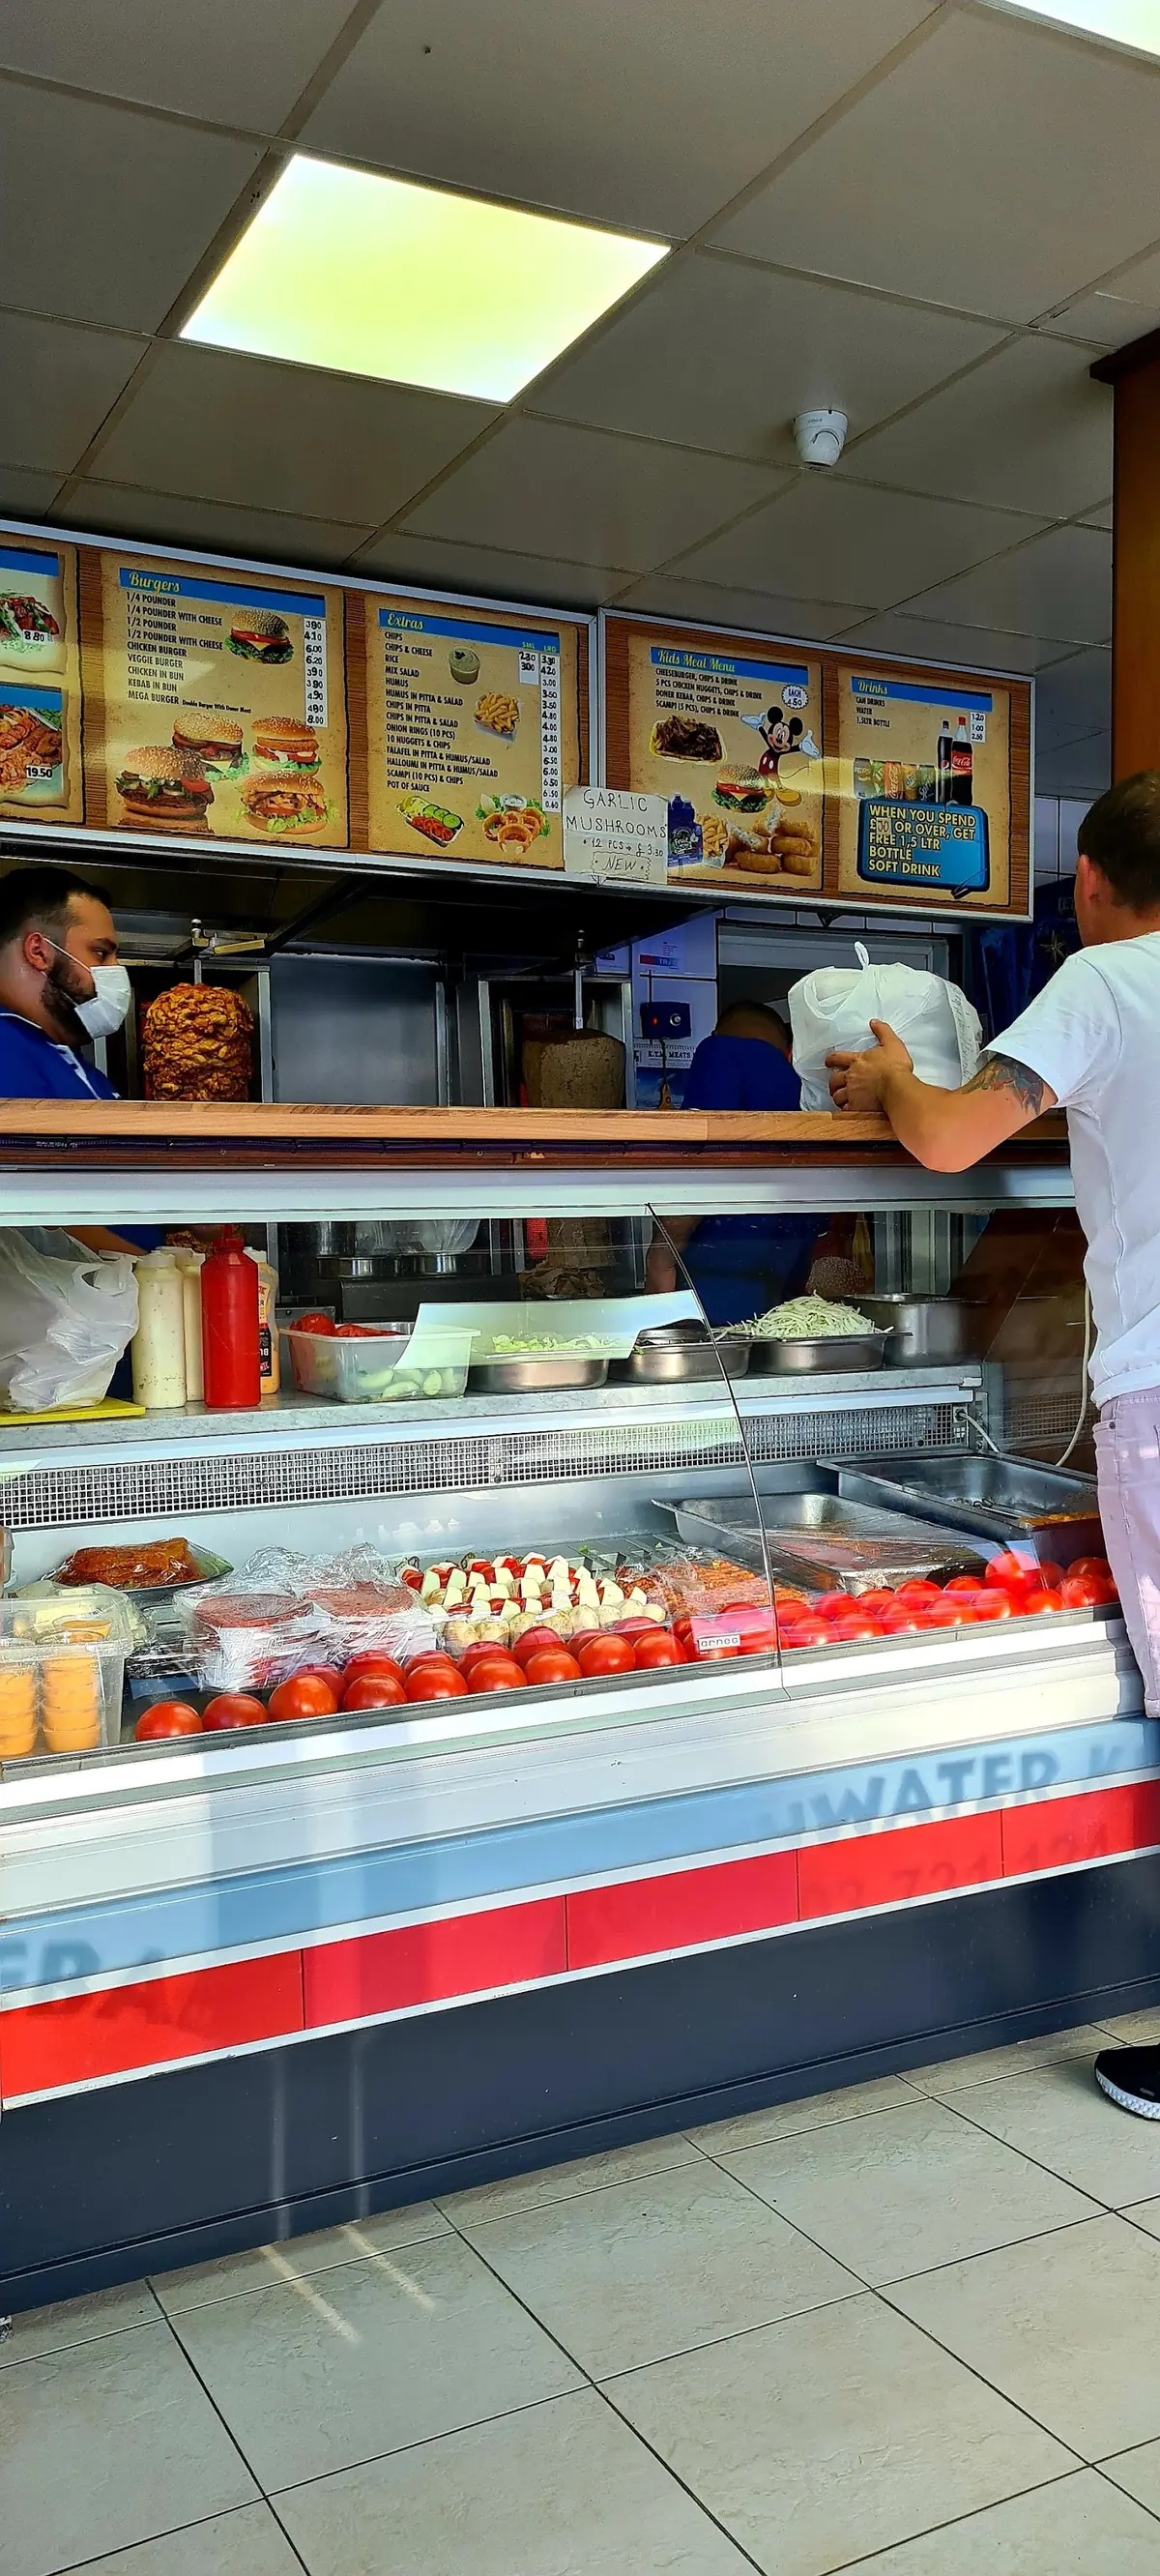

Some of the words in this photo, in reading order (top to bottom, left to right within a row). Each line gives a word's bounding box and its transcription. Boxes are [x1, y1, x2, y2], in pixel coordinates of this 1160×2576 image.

[129, 571, 180, 594] Burgers
[126, 592, 140, 603] 1/4
[142, 594, 176, 607] POUNDER
[127, 604, 140, 615] 1/4
[142, 606, 176, 620] POUNDER
[178, 611, 197, 623] WITH
[198, 615, 222, 627] CHEESE
[127, 616, 141, 627] 1/2
[142, 619, 177, 631] POUNDER
[387, 613, 423, 630] Extras
[127, 629, 141, 639] 1/2
[143, 630, 177, 644] POUNDER
[179, 635, 197, 647] WITH
[199, 639, 223, 651] CHEESE
[384, 631, 403, 641] CHIPS
[127, 641, 157, 653] CHICKEN
[159, 644, 187, 658] BURGER
[385, 642, 403, 653] CHIPS
[411, 647, 433, 657] CHEESE
[128, 653, 153, 665] VEGGIE
[156, 657, 183, 668] BURGER
[385, 655, 399, 663] RICE
[657, 650, 681, 665] Kids
[682, 654, 707, 668] Meal
[709, 658, 735, 673] Menu
[128, 666, 158, 677] CHICKEN
[160, 670, 167, 679] IN
[169, 671, 184, 681] BUN
[385, 665, 398, 674] MIX
[399, 668, 420, 678] SALAD
[655, 667, 698, 682] CHEESEBURGER,
[698, 673, 714, 683] CHIPS
[720, 677, 738, 687] DRINK
[128, 678, 150, 688] KEBAB
[162, 683, 177, 692] BUN
[386, 677, 409, 688] HUMUS
[660, 679, 671, 688] PCS
[672, 681, 695, 690] CHICKEN
[696, 684, 723, 695] NUGGETS,
[723, 688, 739, 696] CHIPS
[745, 691, 763, 700] DRINK
[857, 680, 888, 695] Drinks
[128, 690, 149, 700] MEGA
[151, 693, 179, 705] BURGER
[386, 688, 409, 699] HUMUS
[419, 692, 436, 702] PITTA
[444, 697, 463, 706] SALAD
[655, 689, 675, 698] DONER
[696, 695, 711, 704] CHIPS
[718, 697, 735, 707] DRINK
[788, 688, 801, 698] EACH
[386, 700, 404, 710] CHIPS
[414, 704, 431, 714] PITTA
[655, 700, 677, 710] SCAMPI
[700, 706, 715, 715] CHIPS
[722, 709, 740, 717] DRINK
[856, 696, 866, 705] CAN
[867, 697, 885, 707] DRINKS
[856, 706, 873, 716] WATER
[386, 712, 404, 721] CHIPS
[414, 716, 431, 725] PITTA
[439, 718, 458, 728] SALAD
[541, 721, 557, 731] 4.00
[873, 718, 890, 728] BOTTLE
[386, 723, 407, 733] ONION
[409, 726, 428, 736] RINGS
[442, 730, 456, 740] PCS)
[396, 736, 425, 746] NUGGETS
[433, 740, 450, 749] CHIPS
[387, 746, 411, 756] FALAFEL
[420, 750, 438, 759] PITTA
[446, 753, 491, 766] HUMUS/SALAD
[387, 757, 419, 768] HALLOUMI
[428, 762, 445, 772] PITTA
[453, 765, 498, 777] HUMUS/SALAD
[387, 769, 411, 778] SCAMPI
[412, 772, 422, 780] (10
[423, 774, 438, 783] PCS)
[446, 776, 464, 785] CHIPS
[411, 782, 430, 792] SAUCE
[583, 789, 648, 811] GARLIC
[869, 805, 906, 820] WHEN
[910, 809, 935, 823] YOU
[938, 811, 976, 827] SPEND
[566, 815, 667, 838] MUSHROOMS
[894, 821, 913, 834] OR
[915, 823, 950, 839] OVER,
[953, 828, 975, 840] GET
[592, 837, 602, 848] 12
[608, 839, 624, 850] PCS
[869, 833, 896, 845] FREE
[900, 834, 917, 849] 1,5
[921, 836, 941, 850] LTR
[869, 845, 913, 861] BOTTLE
[602, 855, 637, 871] NEW
[868, 860, 898, 873] SOFT
[902, 863, 941, 877] DRINK
